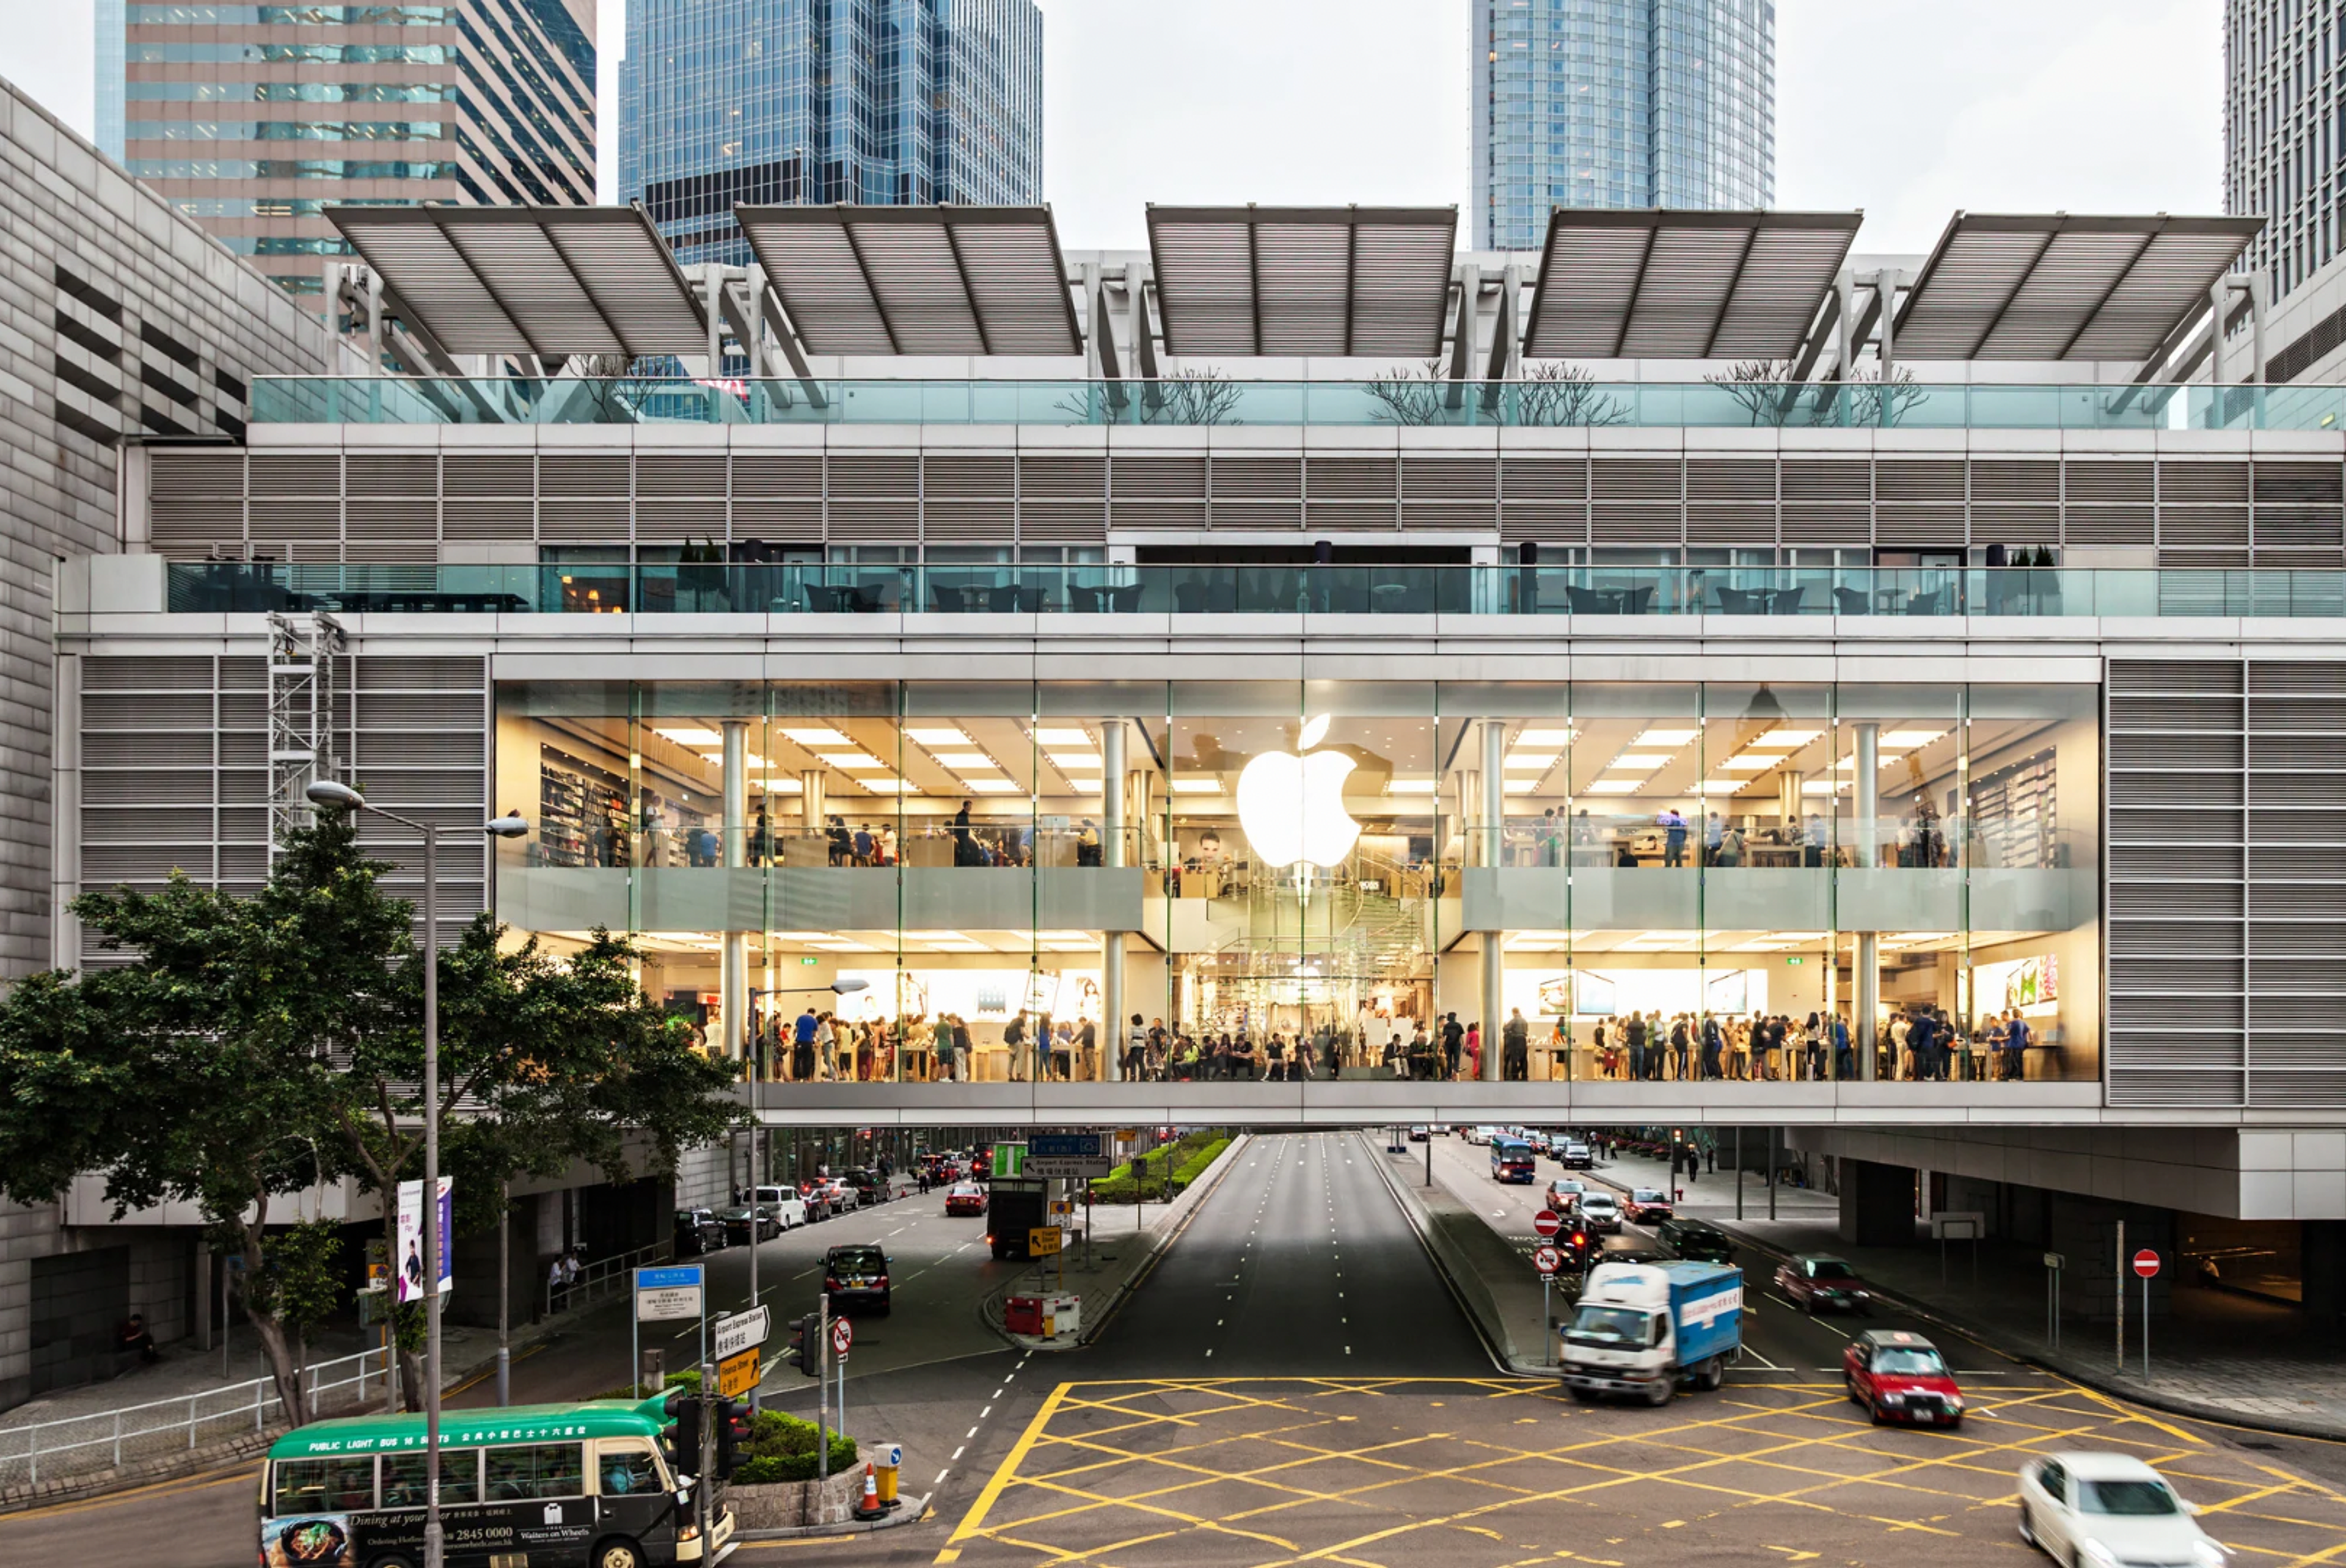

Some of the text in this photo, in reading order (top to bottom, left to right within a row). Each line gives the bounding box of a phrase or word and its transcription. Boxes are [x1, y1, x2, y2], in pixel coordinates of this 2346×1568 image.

[717, 1313, 762, 1334] Airport Express Station
[722, 1359, 748, 1376] Finance Street
[309, 1434, 450, 1452] PUBLIC LIGHT BUS 16 STS
[350, 1515, 388, 1528] Dining
[390, 1514, 401, 1524] at
[402, 1514, 427, 1527] your
[456, 1529, 483, 1541] 2845
[485, 1526, 513, 1538] 0000
[561, 1528, 590, 1537] Wheels
